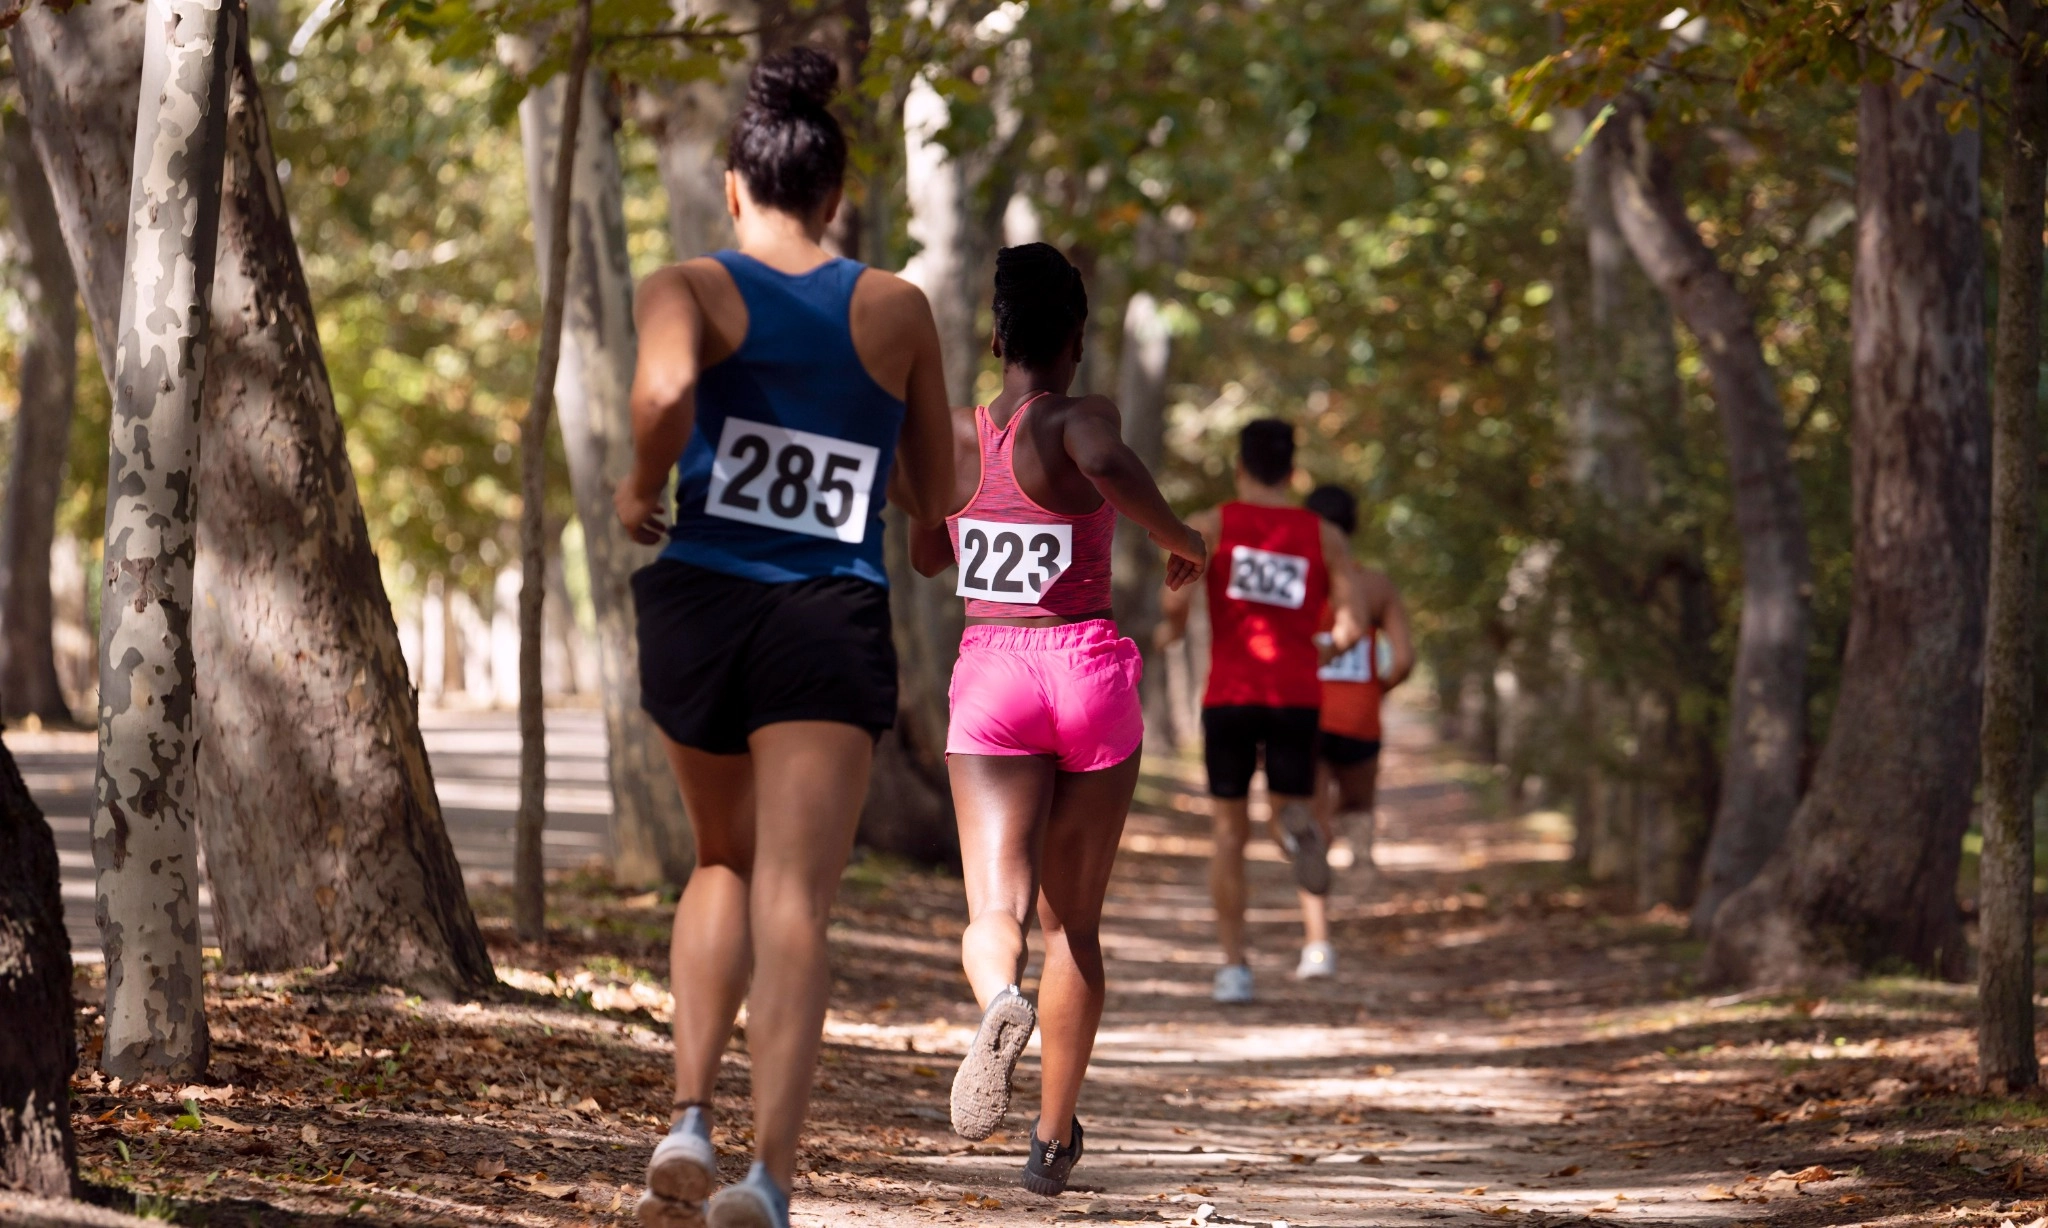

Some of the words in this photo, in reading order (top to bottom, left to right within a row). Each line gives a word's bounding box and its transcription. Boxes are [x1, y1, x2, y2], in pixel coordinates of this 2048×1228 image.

[720, 434, 861, 528] 285
[964, 528, 1061, 594] 223
[1236, 557, 1298, 599] 202
